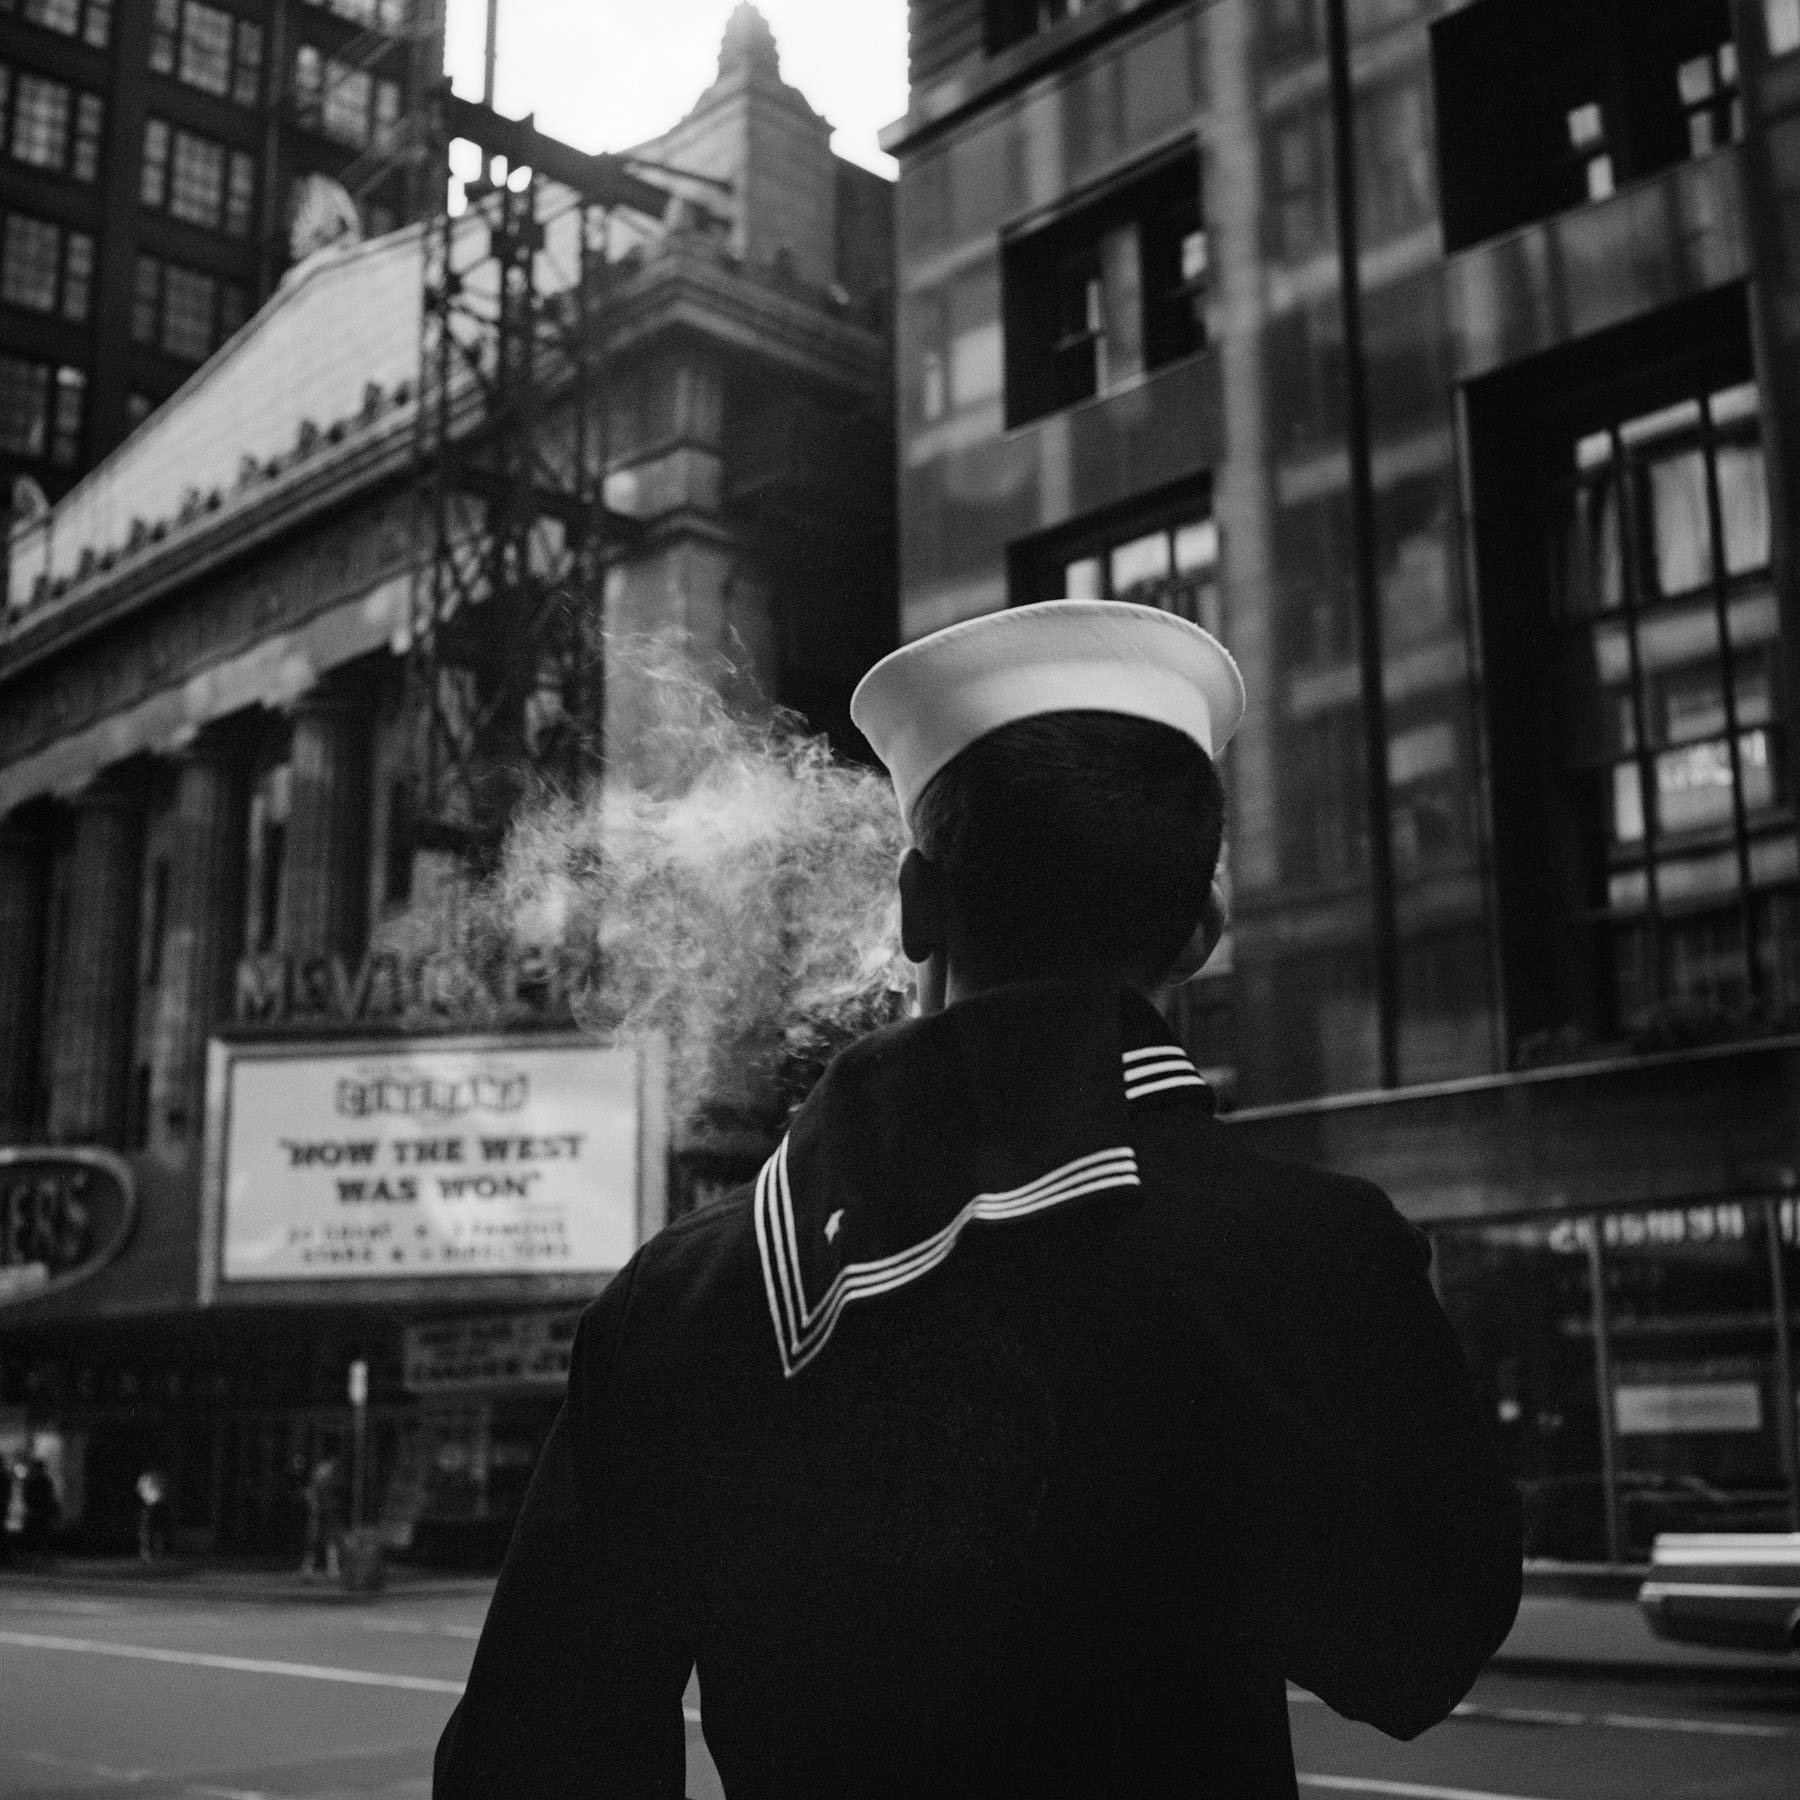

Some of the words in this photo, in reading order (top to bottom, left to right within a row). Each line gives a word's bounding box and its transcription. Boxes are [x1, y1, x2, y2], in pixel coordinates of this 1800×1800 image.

[392, 1137, 464, 1165] THE
[478, 1132, 586, 1162] WEST
[335, 1175, 418, 1203] WAS
